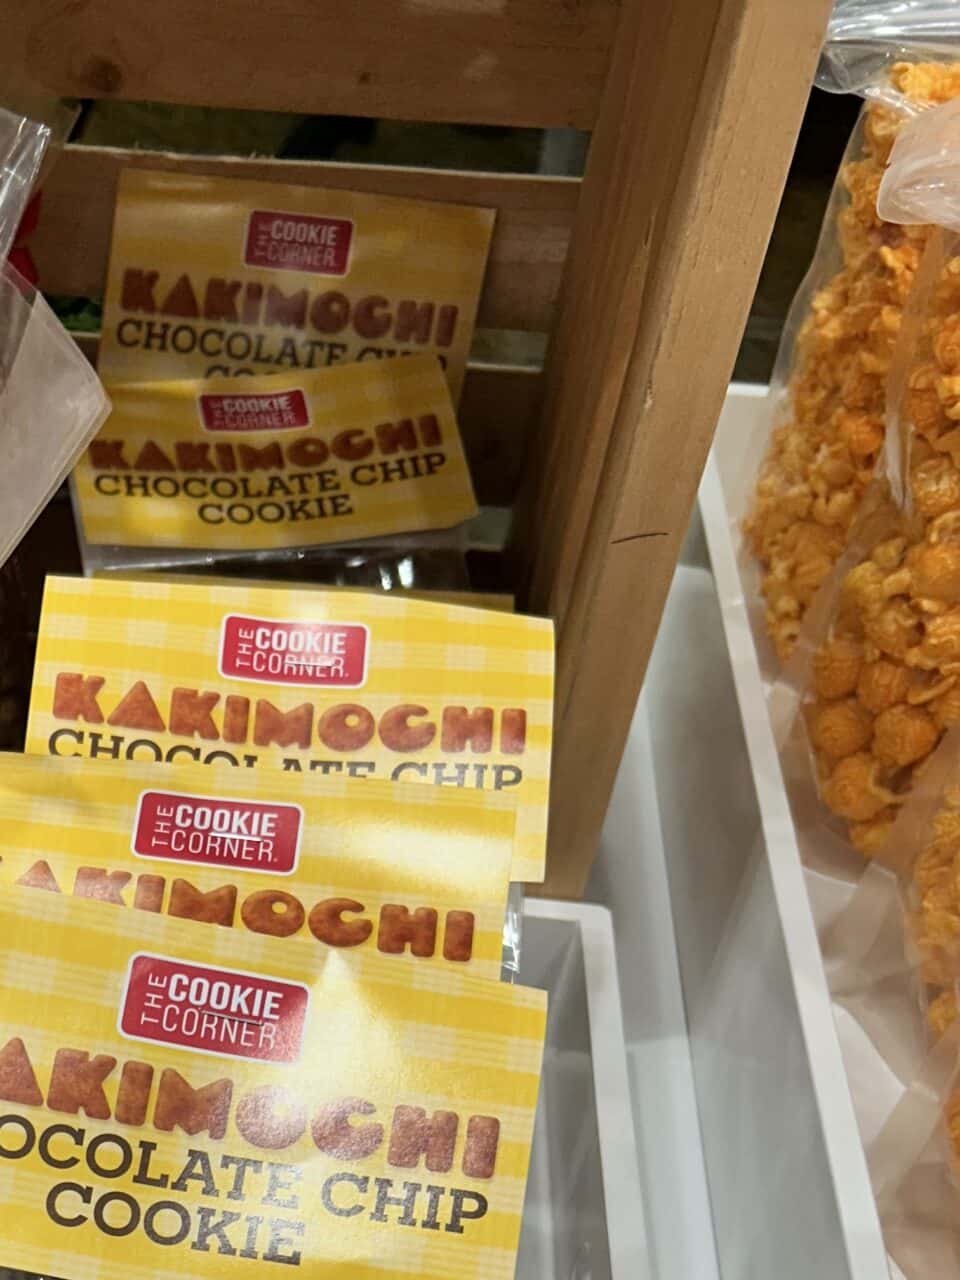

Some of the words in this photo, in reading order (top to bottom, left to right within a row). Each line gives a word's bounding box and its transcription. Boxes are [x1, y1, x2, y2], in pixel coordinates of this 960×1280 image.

[271, 220, 339, 247] COOKIE
[266, 242, 337, 267] CORNER
[120, 267, 460, 348] KAKIMOCHI
[222, 395, 293, 413] COOKIE
[90, 414, 444, 473] KAKIMOCHI
[94, 469, 341, 498] CHOCOLATE
[350, 453, 447, 486] CHIP
[197, 494, 354, 525] COOKIE
[236, 628, 252, 668] THE
[255, 626, 348, 655] COOKIE
[251, 649, 345, 679] CORNER
[52, 671, 528, 756] KAKIMOCHI
[152, 805, 172, 846] THE
[175, 803, 279, 838] COOKIE
[170, 832, 275, 863] CORNER
[141, 972, 167, 1025] THE
[167, 972, 284, 1022] COOKIE
[161, 1003, 277, 1051] CORNER
[321, 1171, 489, 1235] CHIP
[46, 1182, 307, 1266] COOKIE
